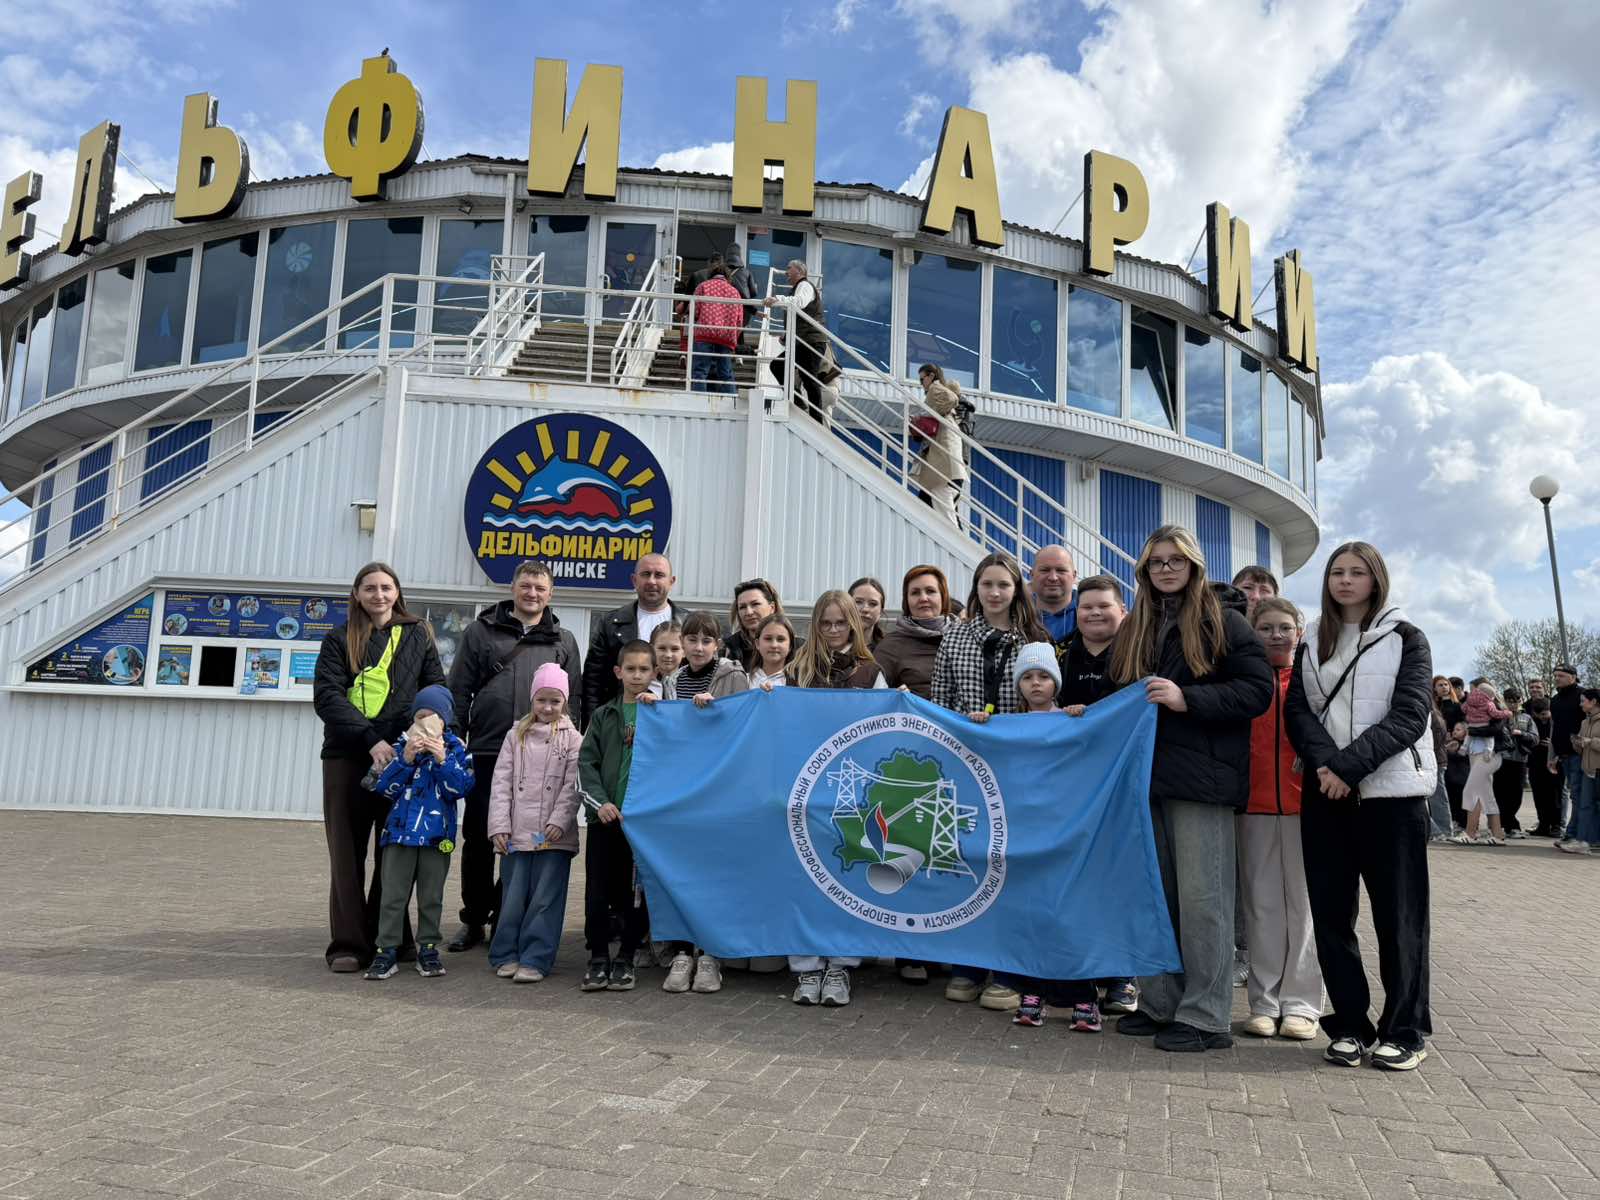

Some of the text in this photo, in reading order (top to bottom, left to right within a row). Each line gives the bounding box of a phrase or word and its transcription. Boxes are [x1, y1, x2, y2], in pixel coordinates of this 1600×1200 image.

[478, 530, 654, 560] ДЕЛЬФИНАРИЙ
[831, 717, 896, 750] РАБОТНИКОВ
[901, 717, 962, 755] ЭНЕРГЕТИКИ,
[807, 747, 832, 775] СОЮЗ
[966, 754, 998, 798] ГАЗОВОЙ
[990, 801, 1001, 811] И
[791, 776, 829, 884] ПРОФЕССИОНАЛЬНЫЙ
[827, 883, 897, 926] БЕЛОРУССКИЙ
[923, 874, 1000, 929] ПРОМЫШЛЕННОСТИ
